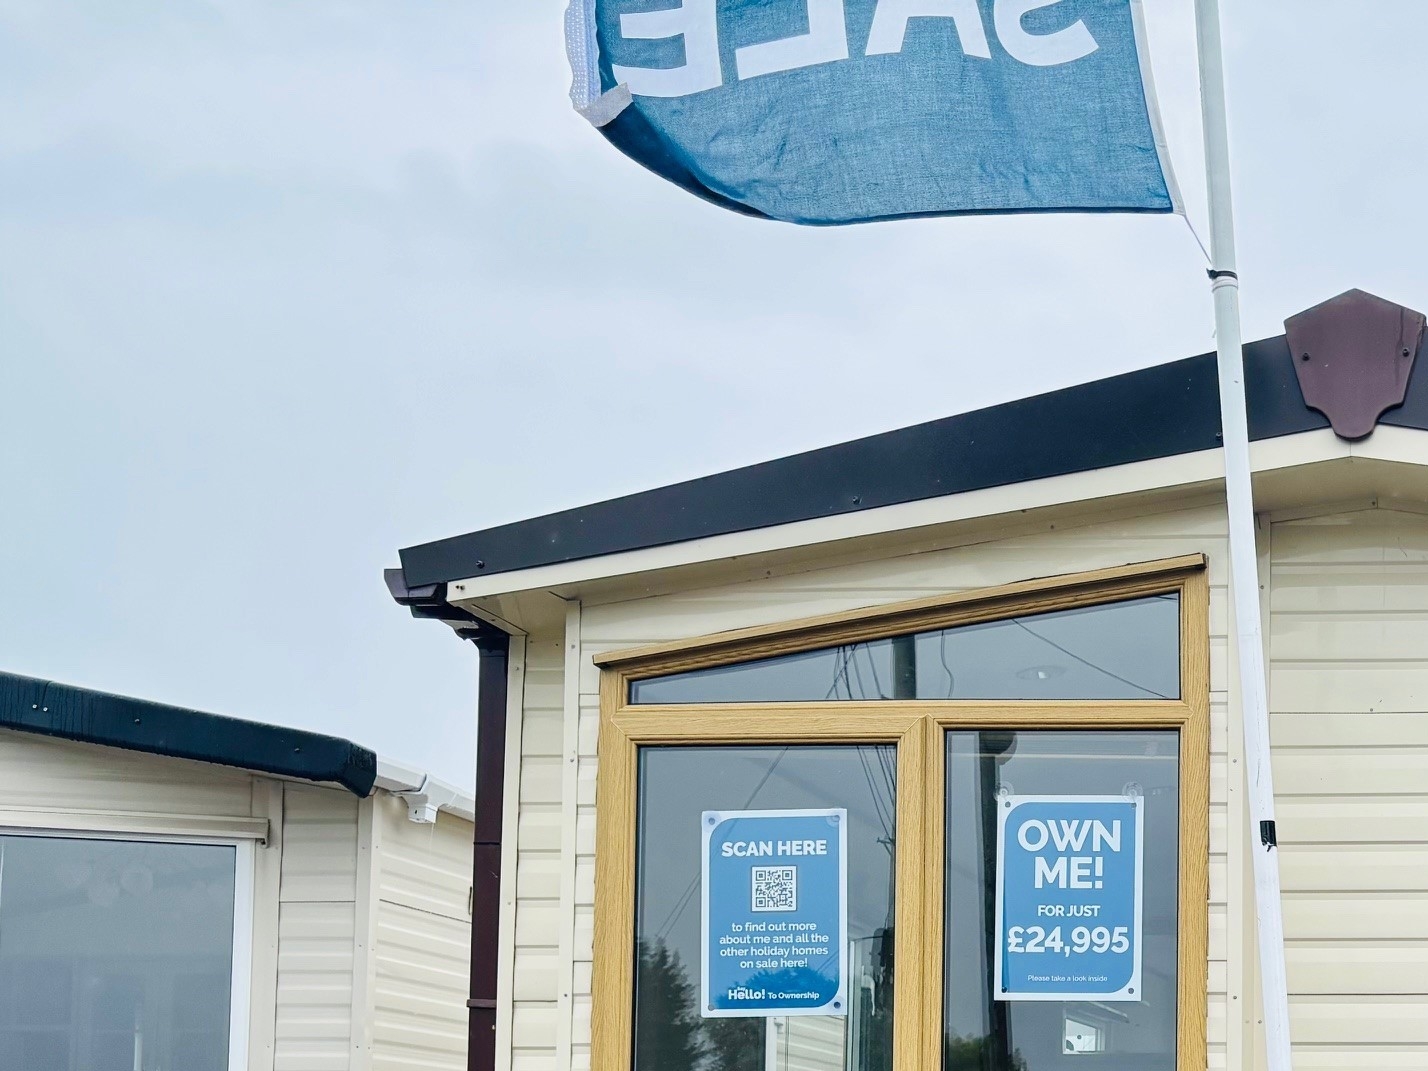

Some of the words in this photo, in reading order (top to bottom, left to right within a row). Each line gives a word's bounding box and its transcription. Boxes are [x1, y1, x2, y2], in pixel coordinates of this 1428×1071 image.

[1017, 819, 1121, 852] OWN
[722, 841, 773, 857] SCAN
[778, 840, 827, 856] HERE
[1035, 857, 1103, 888] ME!
[1038, 905, 1064, 916] FOR
[1067, 905, 1100, 916] JUST
[732, 923, 742, 932] to
[745, 922, 766, 932] find
[769, 922, 786, 931] out
[789, 923, 816, 931] more
[719, 935, 750, 944] about
[753, 936, 770, 944] me
[773, 934, 793, 943] and
[796, 934, 809, 943] all
[811, 934, 829, 943] the
[1008, 926, 1129, 957] £24,995
[720, 947, 748, 957] other
[751, 947, 789, 958] holiday
[792, 946, 828, 955] homes
[740, 960, 753, 969] on
[756, 959, 778, 968] sale
[781, 958, 808, 967] here!
[728, 989, 765, 1000] Hello!
[778, 992, 819, 1000] Ownership
